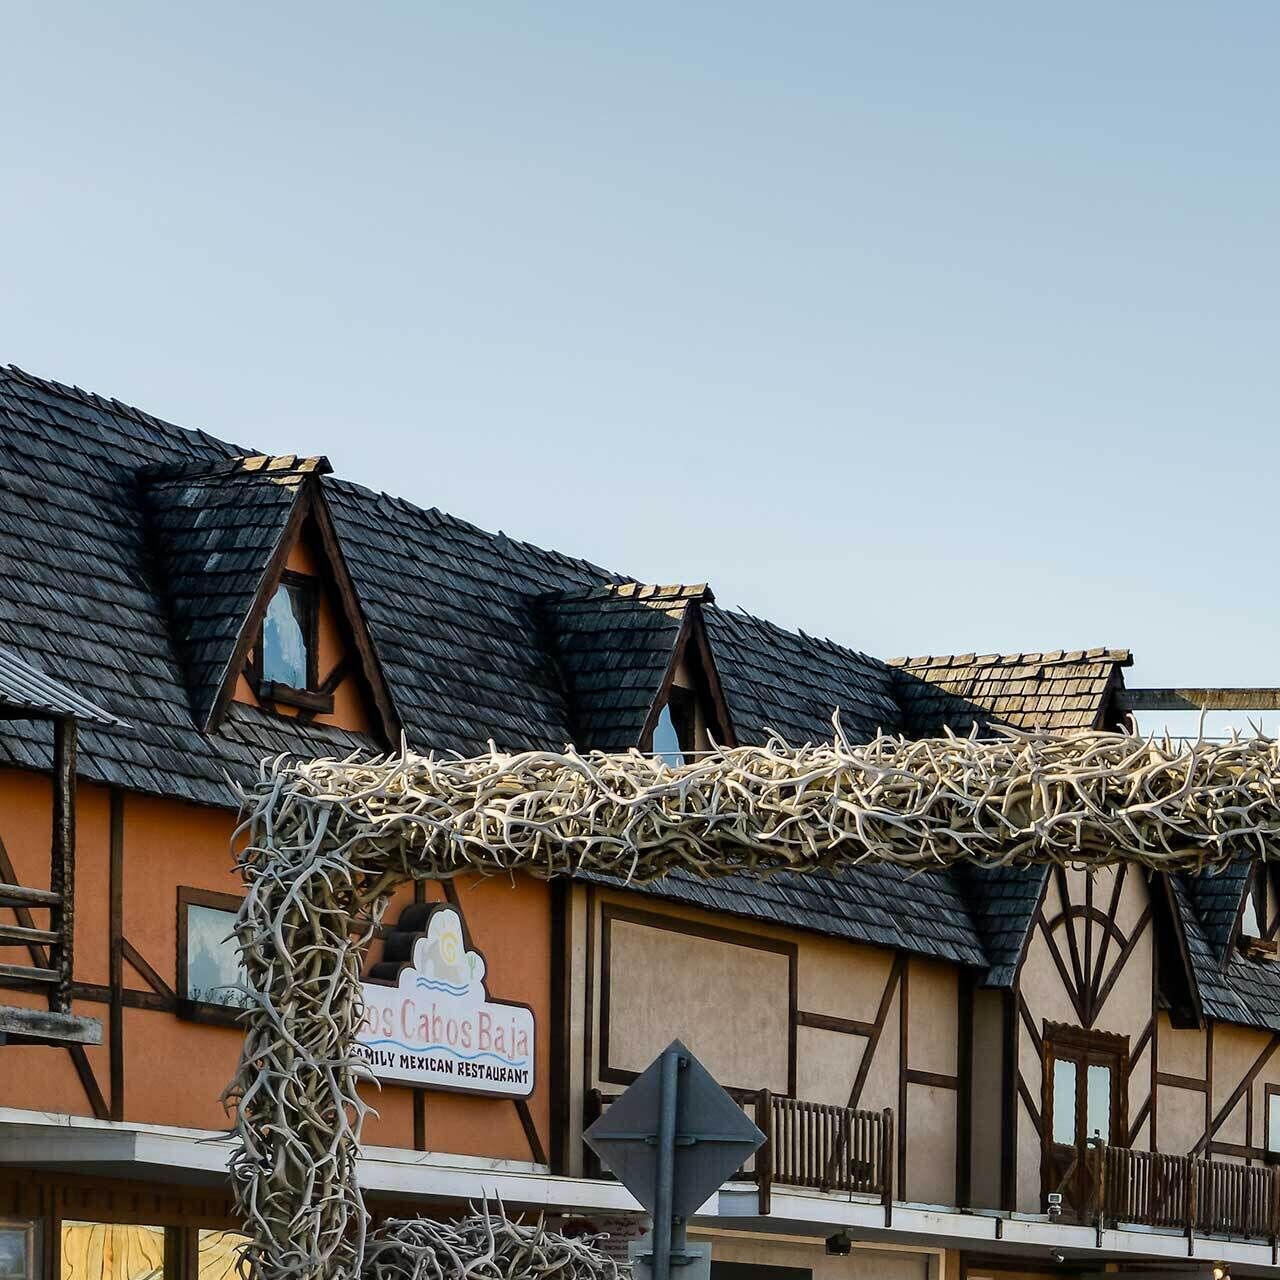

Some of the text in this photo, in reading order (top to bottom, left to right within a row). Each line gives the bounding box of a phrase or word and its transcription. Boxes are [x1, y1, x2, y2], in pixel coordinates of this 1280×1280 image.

[400, 998, 473, 1049] Cabos
[478, 1011, 529, 1060] Baja
[399, 1055, 454, 1074] MEXICAN
[457, 1062, 529, 1085] RESTAURANT
